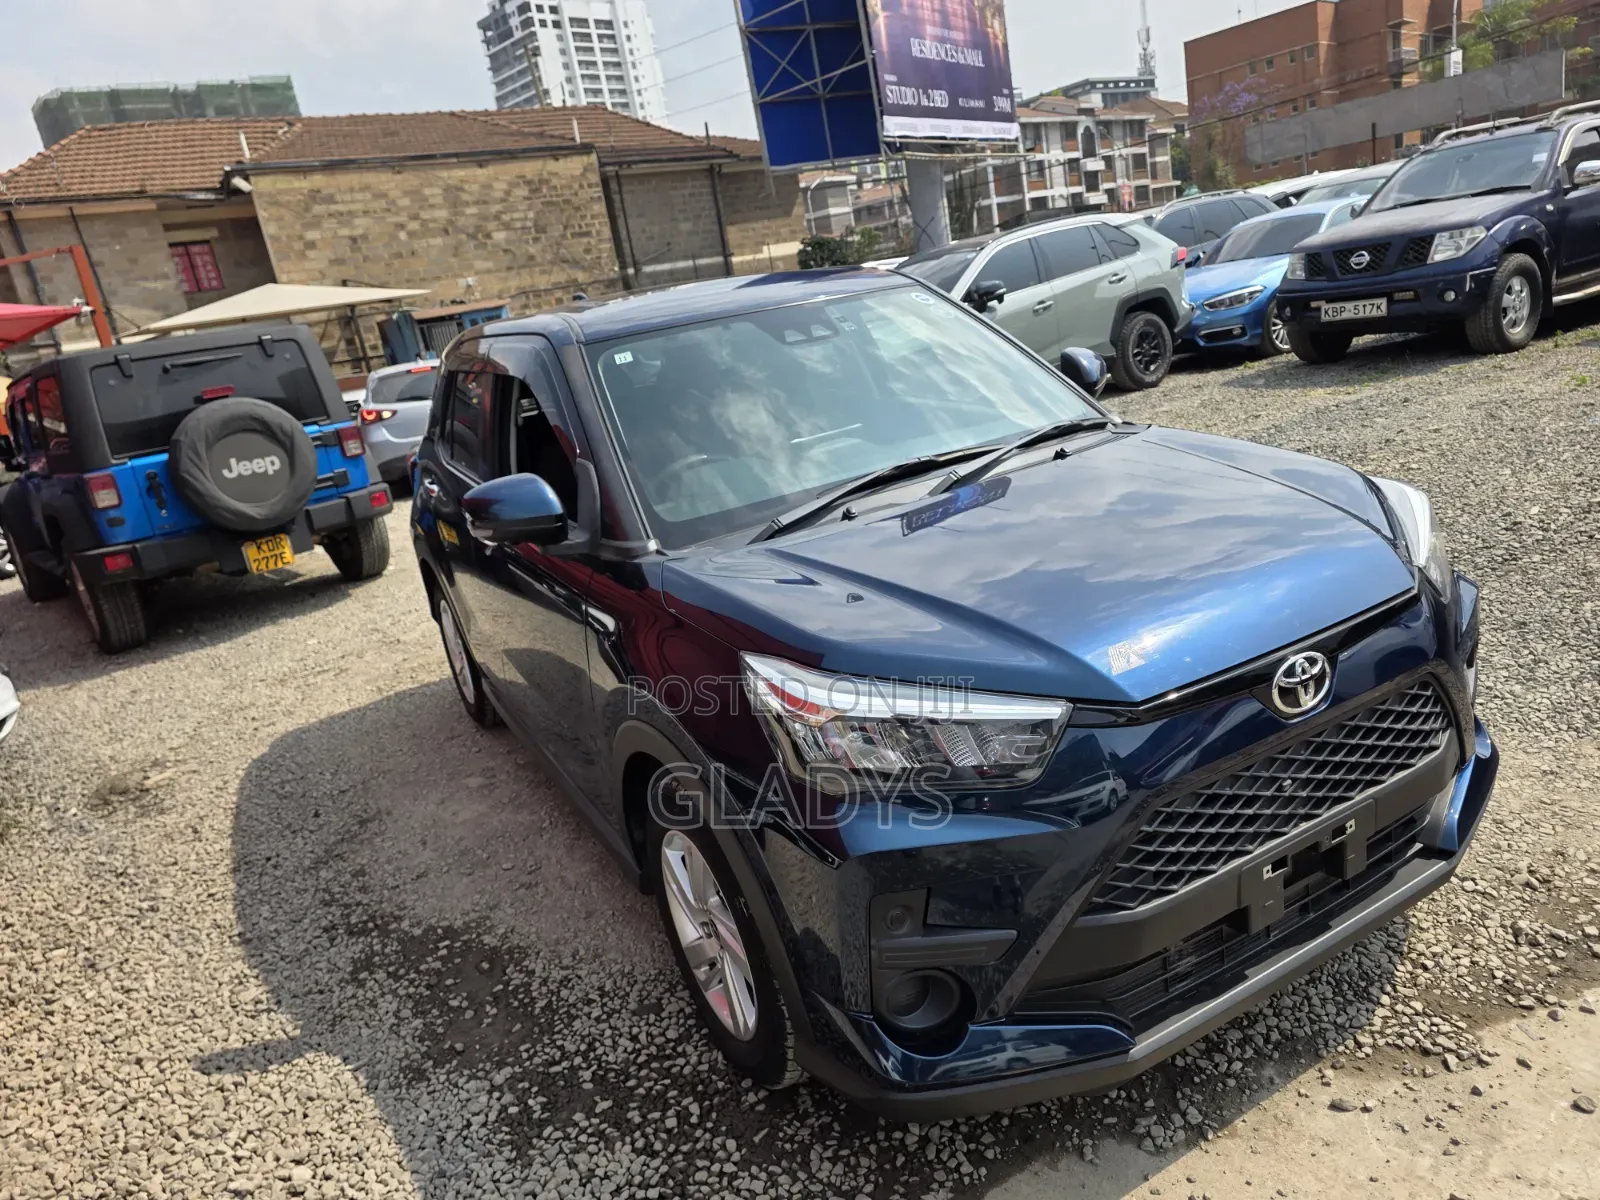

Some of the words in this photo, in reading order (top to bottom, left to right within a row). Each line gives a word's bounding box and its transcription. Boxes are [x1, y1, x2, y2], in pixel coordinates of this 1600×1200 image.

[910, 37, 957, 63] RESIDENCES
[885, 84, 918, 106] STUDIO
[1323, 305, 1346, 318] KBP
[1353, 302, 1384, 316] 517K
[222, 455, 281, 479] Jeep
[255, 536, 285, 554] KDR
[253, 551, 290, 572] 277E
